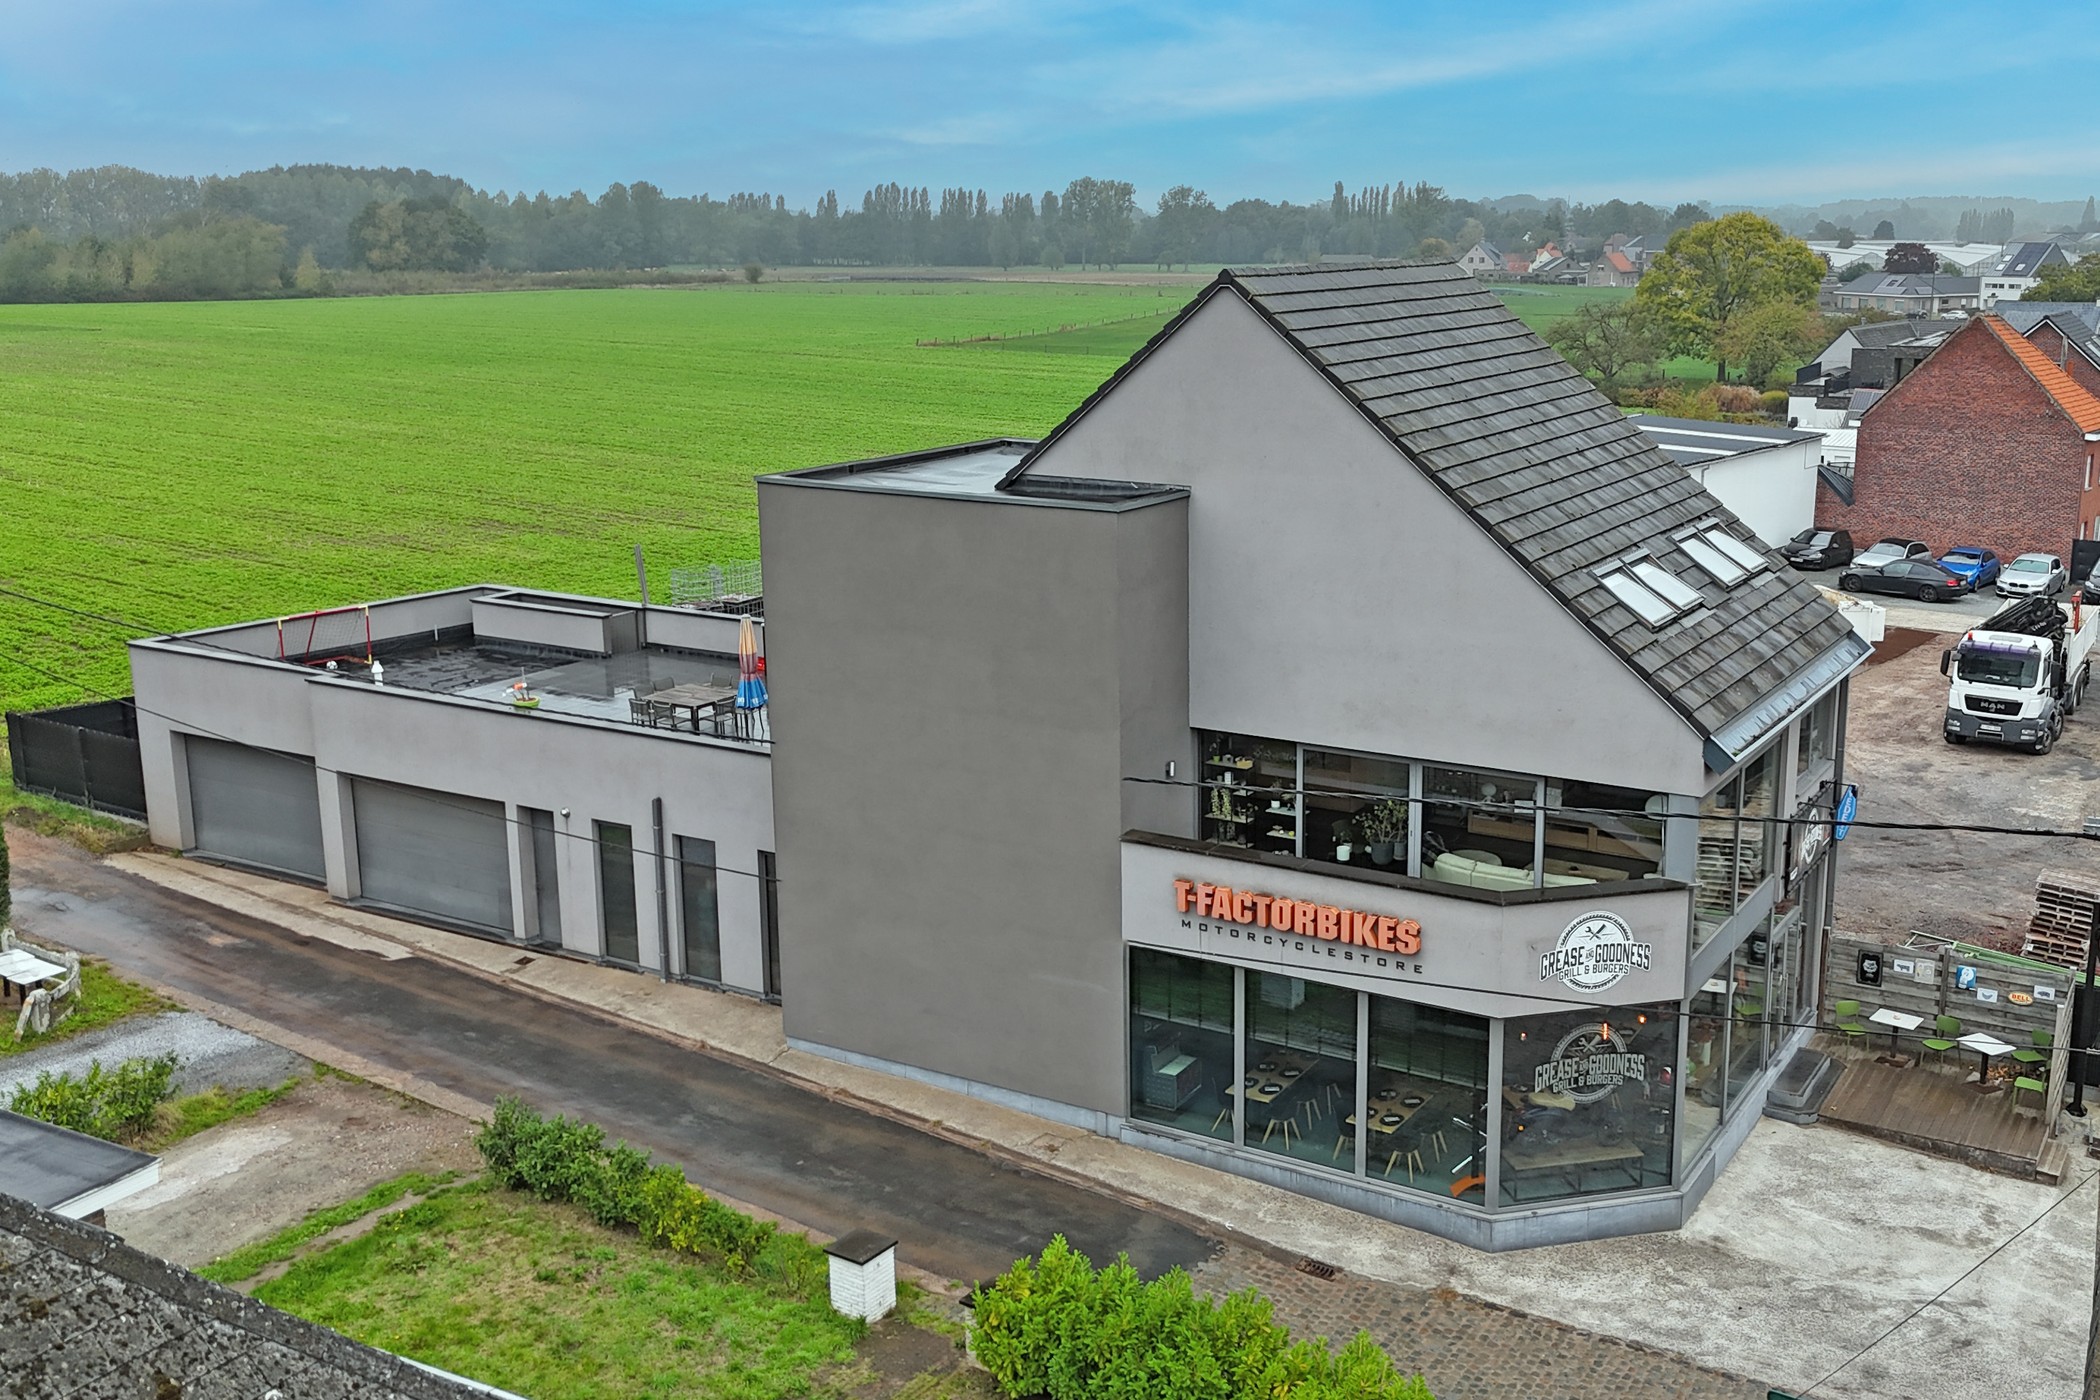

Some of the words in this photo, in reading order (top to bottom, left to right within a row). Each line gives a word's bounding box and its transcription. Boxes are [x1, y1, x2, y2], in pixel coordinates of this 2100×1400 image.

[1980, 701, 2005, 710] MAN
[1173, 879, 1421, 955] T-FACTORBIKES
[1181, 919, 1423, 974] MOTORCYCLESTORE
[1540, 946, 1585, 981] GREASE
[1595, 943, 1651, 970] GOODNESS
[1559, 966, 1582, 981] GRILL
[1584, 965, 1590, 974] &
[1592, 963, 1630, 975] BURGERS
[2011, 993, 2029, 1002] BELL
[1534, 1057, 1580, 1094] GREASE
[1588, 1053, 1645, 1081] GOODNESS
[1552, 1078, 1577, 1093] GRILL
[1578, 1076, 1585, 1086] &
[1586, 1074, 1624, 1086] BURGERS
